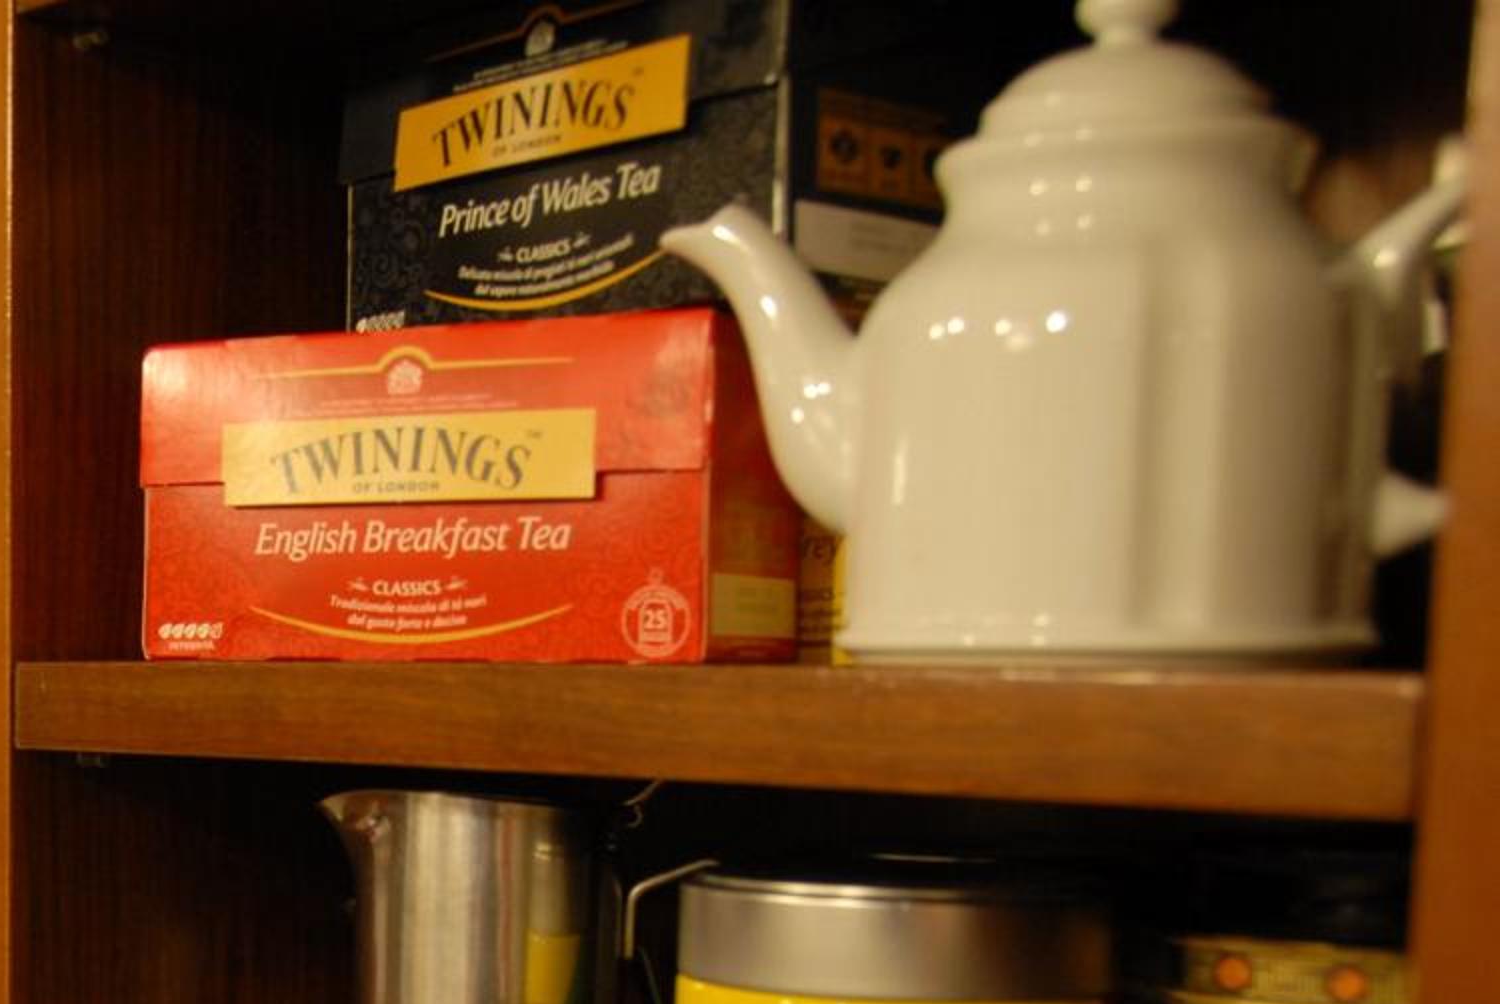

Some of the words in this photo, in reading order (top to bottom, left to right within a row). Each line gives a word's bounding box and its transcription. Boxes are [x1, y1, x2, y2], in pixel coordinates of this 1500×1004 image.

[431, 79, 636, 168] TWININGS
[438, 198, 511, 239] Prince
[510, 183, 541, 229] of
[540, 172, 613, 215] Wales
[615, 161, 663, 200] Tea
[270, 425, 532, 493] TWININGS
[254, 520, 356, 562] English
[362, 516, 510, 560] Breakfast
[516, 515, 573, 551] Tea
[371, 579, 443, 596] CLASSICS
[642, 607, 668, 629] 25
